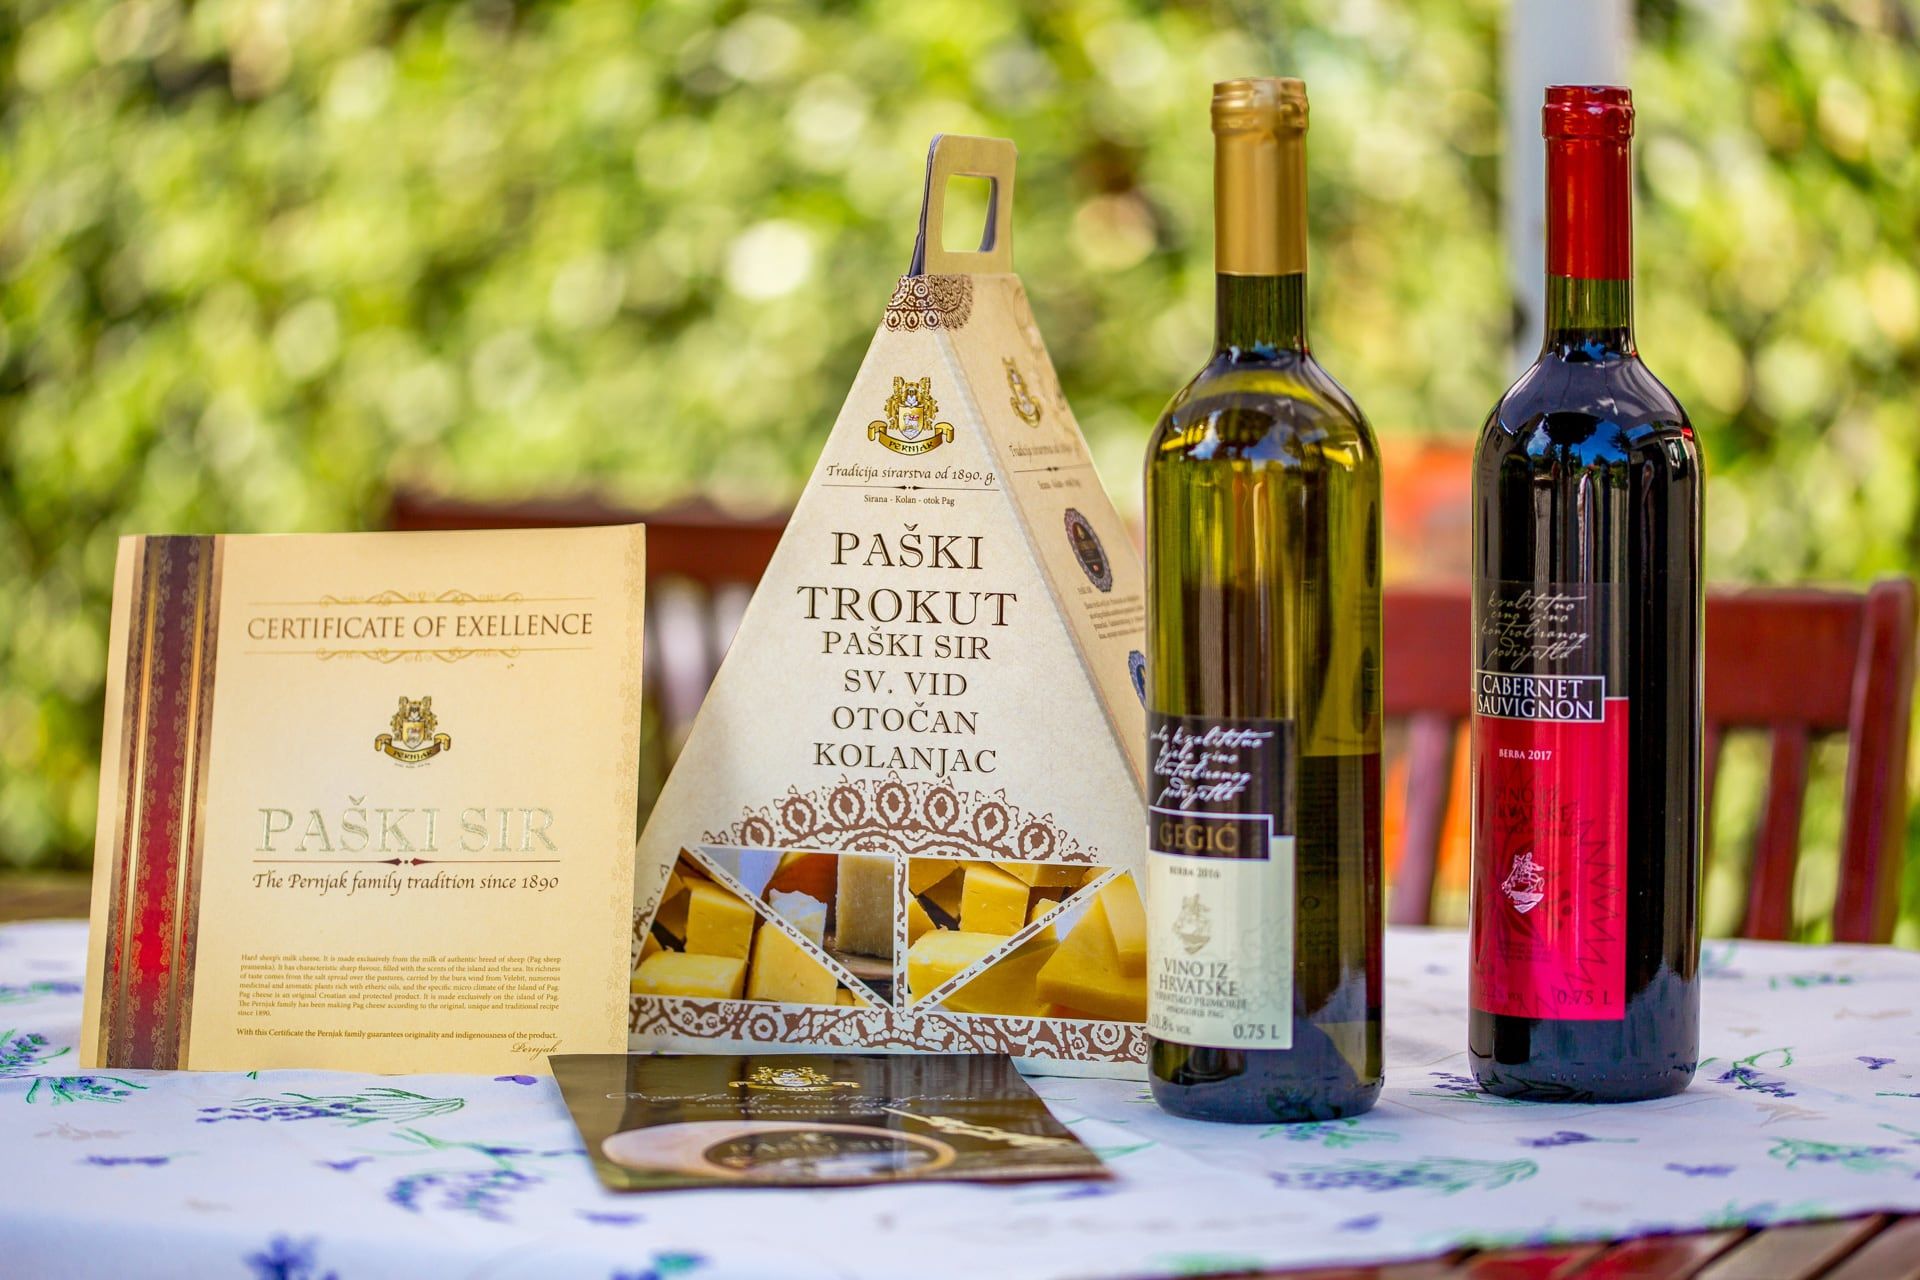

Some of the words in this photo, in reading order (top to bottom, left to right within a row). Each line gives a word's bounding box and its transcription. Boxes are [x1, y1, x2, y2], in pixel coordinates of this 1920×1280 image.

[826, 463, 878, 482] Tradicija
[882, 467, 931, 480] sirarstva
[935, 466, 951, 480] od
[952, 470, 982, 483] 1890.
[984, 472, 996, 486] g.
[864, 494, 888, 503] Sirana
[895, 496, 917, 504] Kolan
[923, 496, 940, 505] otok
[942, 497, 955, 506] Pag
[830, 523, 984, 570] PAŠKI
[797, 586, 1018, 626] TROKUT
[247, 616, 405, 640] CERTIFICATE
[413, 614, 448, 638] OF
[456, 612, 593, 637] EXELLENCE
[821, 626, 924, 658] PAŠKI
[934, 634, 991, 660] SIR
[844, 669, 893, 694] SV.
[904, 672, 968, 696] VID
[1482, 675, 1584, 699] CABERNET
[832, 701, 979, 735] OTOČAN
[1478, 694, 1593, 719] SAUVIGNON
[813, 742, 997, 778] KOLANJAC
[1499, 748, 1525, 760] BERBA
[1528, 750, 1552, 760] 2017
[256, 794, 440, 853] PAŠKI
[459, 807, 560, 852] SIR
[1159, 822, 1238, 853] GEGIĆ
[252, 870, 284, 890] The
[288, 870, 348, 896] Pernjak
[347, 870, 402, 896] family
[406, 870, 475, 890] tradition
[480, 872, 516, 890] since
[522, 875, 559, 892] 1890
[282, 954, 297, 962] milk
[323, 954, 329, 962] It
[330, 954, 335, 962] is
[337, 954, 355, 962] made
[478, 955, 497, 963] breed
[498, 955, 506, 963] of
[506, 955, 526, 965] sheep
[543, 956, 562, 965] sheep
[1164, 957, 1204, 979] VINO
[1210, 962, 1228, 980] IZ
[239, 991, 250, 1000] Pag
[292, 991, 317, 1000] original
[318, 991, 346, 999] Croatian
[349, 991, 361, 999] and
[362, 992, 393, 1001] protected
[503, 992, 514, 1000] the
[314, 982, 333, 991] plants
[335, 982, 348, 990] rich
[349, 982, 363, 990] with
[473, 983, 497, 991] climate
[497, 983, 505, 991] of
[505, 983, 516, 991] the
[537, 983, 546, 991] of
[1159, 974, 1239, 998] HRVATSKE
[1557, 990, 1594, 1005] 0.75
[1603, 990, 1612, 1005] L
[251, 1000, 276, 1009] Pernjak
[277, 1000, 297, 1009] family
[298, 1000, 309, 1008] has
[310, 1000, 325, 1008] been
[327, 1001, 351, 1010] making
[352, 1001, 364, 1010] Pag
[387, 1001, 419, 1010] according
[419, 1001, 427, 1009] to
[427, 1001, 438, 1009] the
[539, 1002, 560, 1011] recipe
[255, 1009, 272, 1017] 1890.
[268, 1029, 304, 1037] Certificate
[305, 1029, 316, 1037] the
[317, 1030, 343, 1039] Pernjak
[344, 1030, 366, 1039] family
[367, 1030, 404, 1039] guarantees
[404, 1030, 439, 1040] originality
[455, 1031, 507, 1040] indigenousness
[507, 1031, 515, 1039] of
[516, 1031, 528, 1039] the
[528, 1031, 558, 1041] product.
[1233, 1024, 1264, 1040] 0.75
[1271, 1024, 1280, 1040] L
